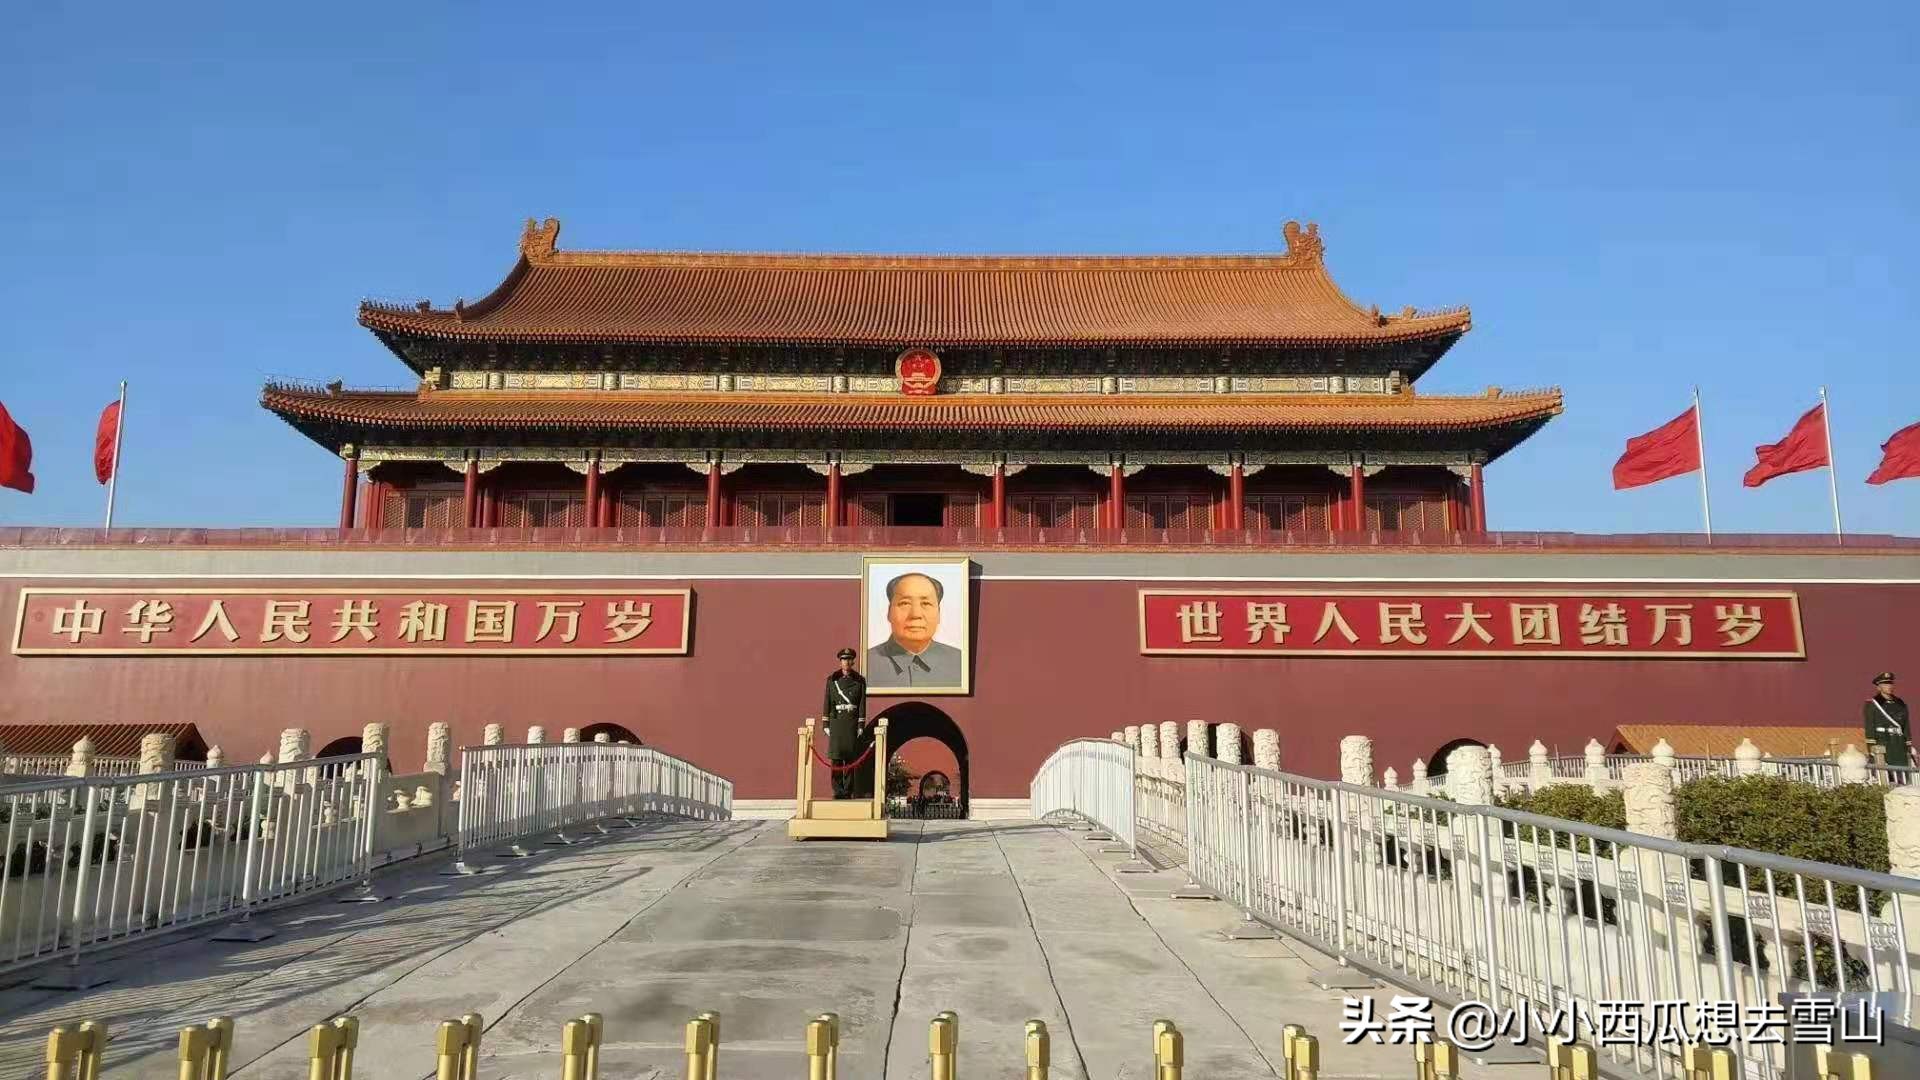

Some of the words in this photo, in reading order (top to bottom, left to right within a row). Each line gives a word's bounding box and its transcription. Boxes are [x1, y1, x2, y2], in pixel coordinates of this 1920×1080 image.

[51, 599, 656, 645] 中华人民共和国万岁
[1176, 602, 1766, 647] 世界人民大团结万岁
